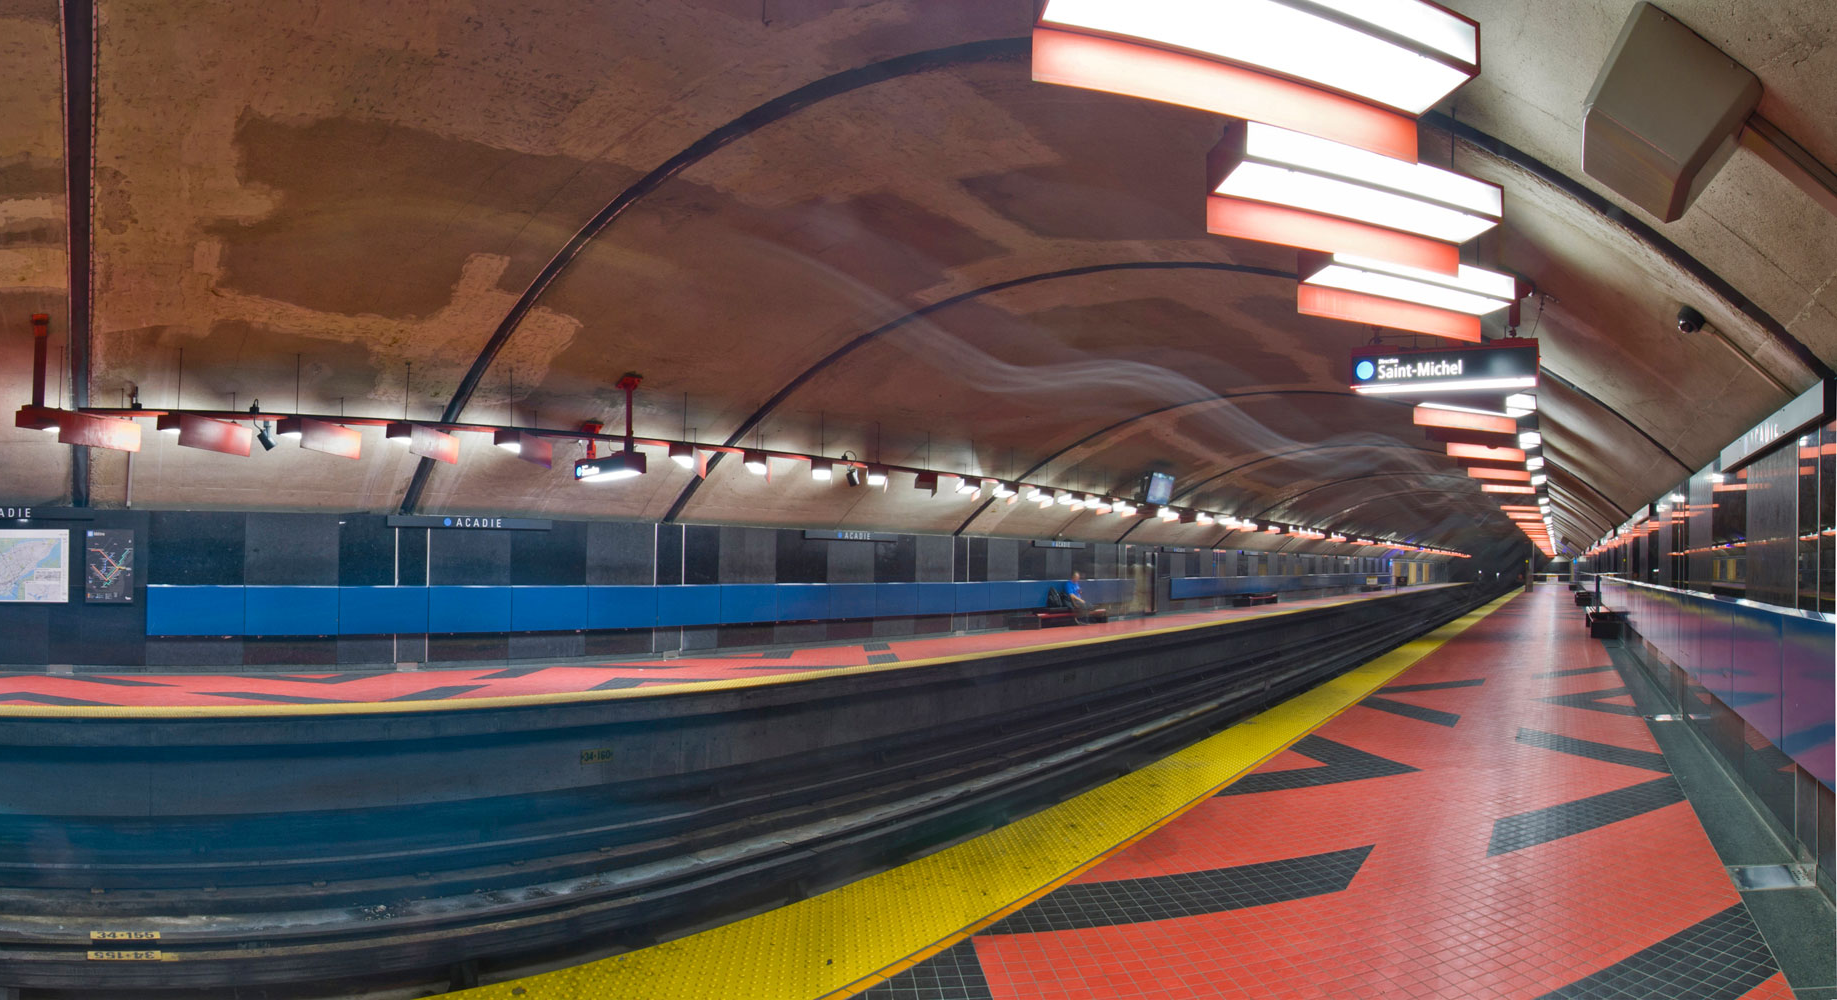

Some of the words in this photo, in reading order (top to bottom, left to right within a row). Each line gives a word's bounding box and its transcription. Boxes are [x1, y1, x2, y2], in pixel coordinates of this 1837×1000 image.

[1377, 359, 1463, 379] Saint-Michel
[456, 517, 502, 528] ACADIE
[844, 531, 871, 540] ACADIE
